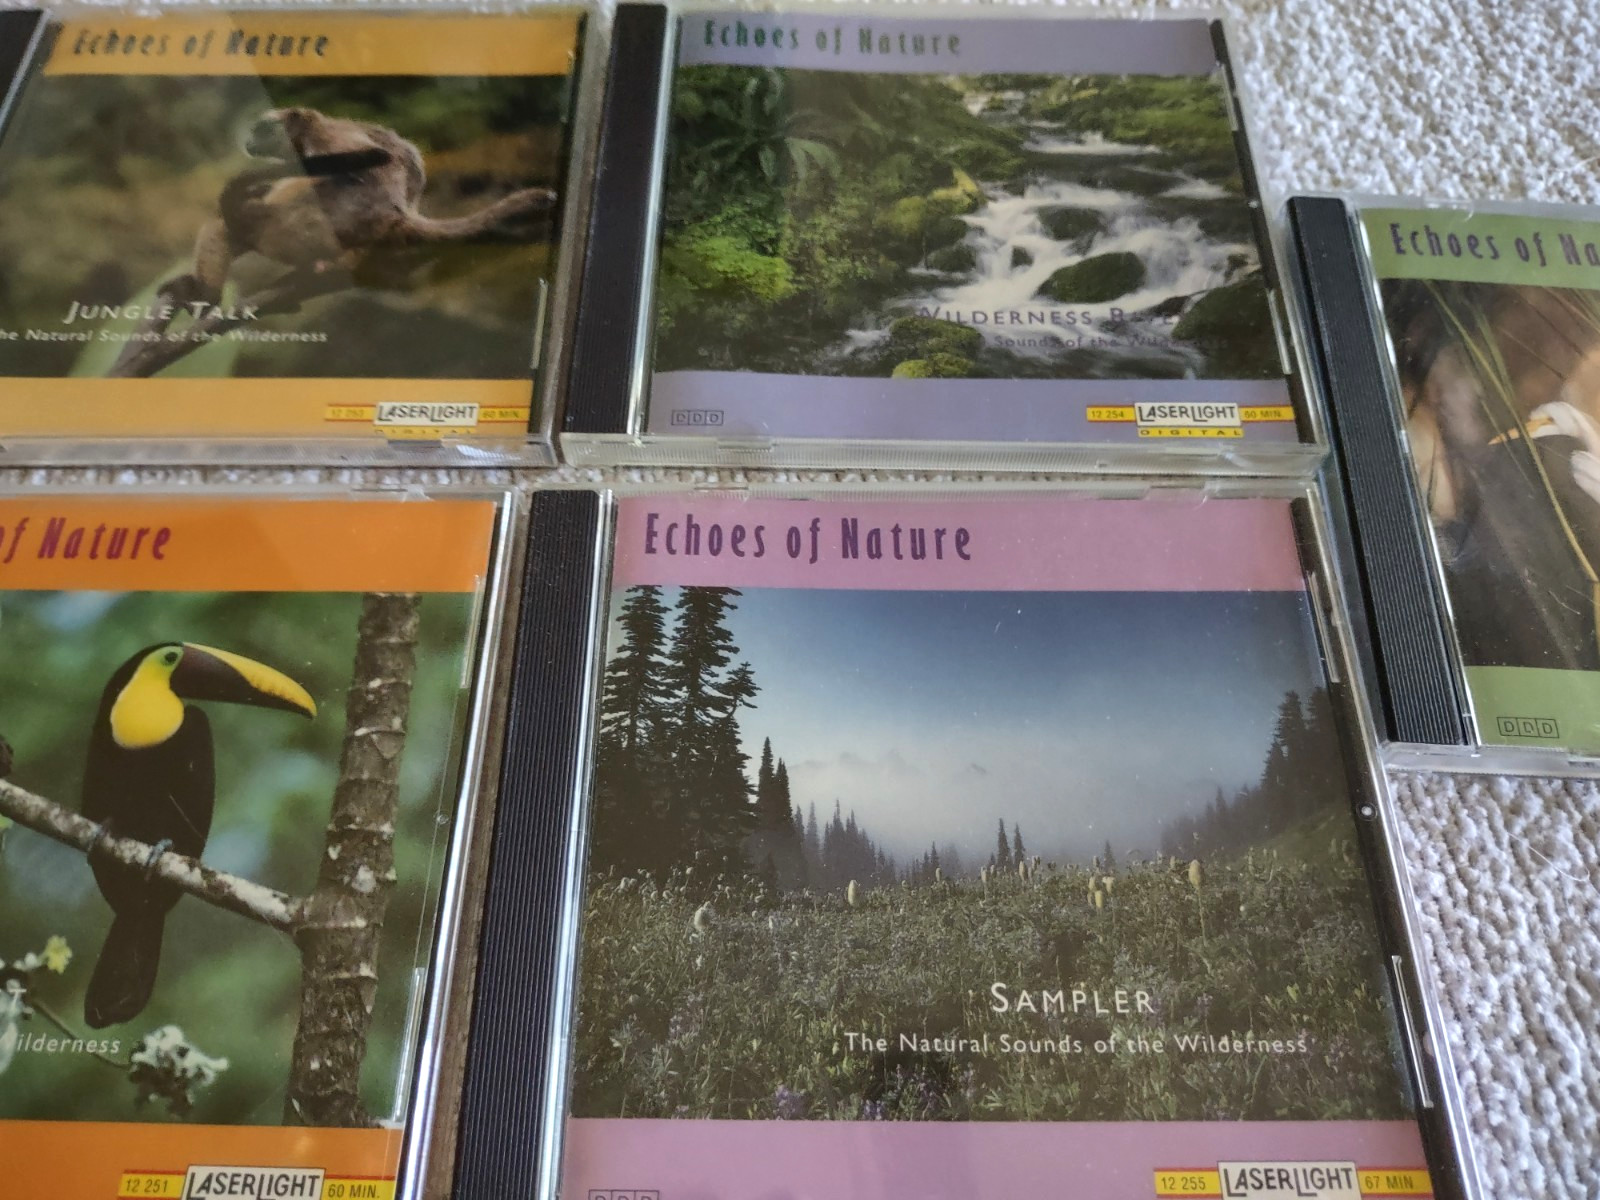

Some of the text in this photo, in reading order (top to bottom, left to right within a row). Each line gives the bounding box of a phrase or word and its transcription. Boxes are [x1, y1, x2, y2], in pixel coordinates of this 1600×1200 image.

[74, 28, 329, 59] Echoes of Nature
[704, 20, 960, 55] Echoes of Nature
[1389, 223, 1500, 260] Echoes
[1514, 231, 1547, 267] of
[63, 300, 259, 325] JUNGLE TALK
[25, 329, 93, 342] Natural
[99, 329, 161, 343] Sounds
[167, 330, 189, 343] of
[190, 330, 223, 343] the
[227, 329, 328, 343] Wilderness
[1066, 336, 1084, 350] of
[377, 405, 477, 422] LASERLIGHT
[1138, 406, 1236, 422] LASERLIGHT
[1140, 428, 1241, 436] DIGITAL
[37, 517, 172, 560] Nature
[644, 512, 972, 564] Echoes of Nature
[991, 982, 1155, 1013] SAMPLER
[4, 1032, 121, 1053] ilderness
[844, 1032, 1308, 1053] The Natural Sounds of the Wilderness
[126, 1172, 380, 1200] 12 251 LASERLIGHT 60 MIN.
[1161, 1176, 1175, 1189] 12
[1181, 1176, 1206, 1190] 255
[1223, 1168, 1352, 1197] LASERLIGHT
[1364, 1175, 1380, 1190] 67
